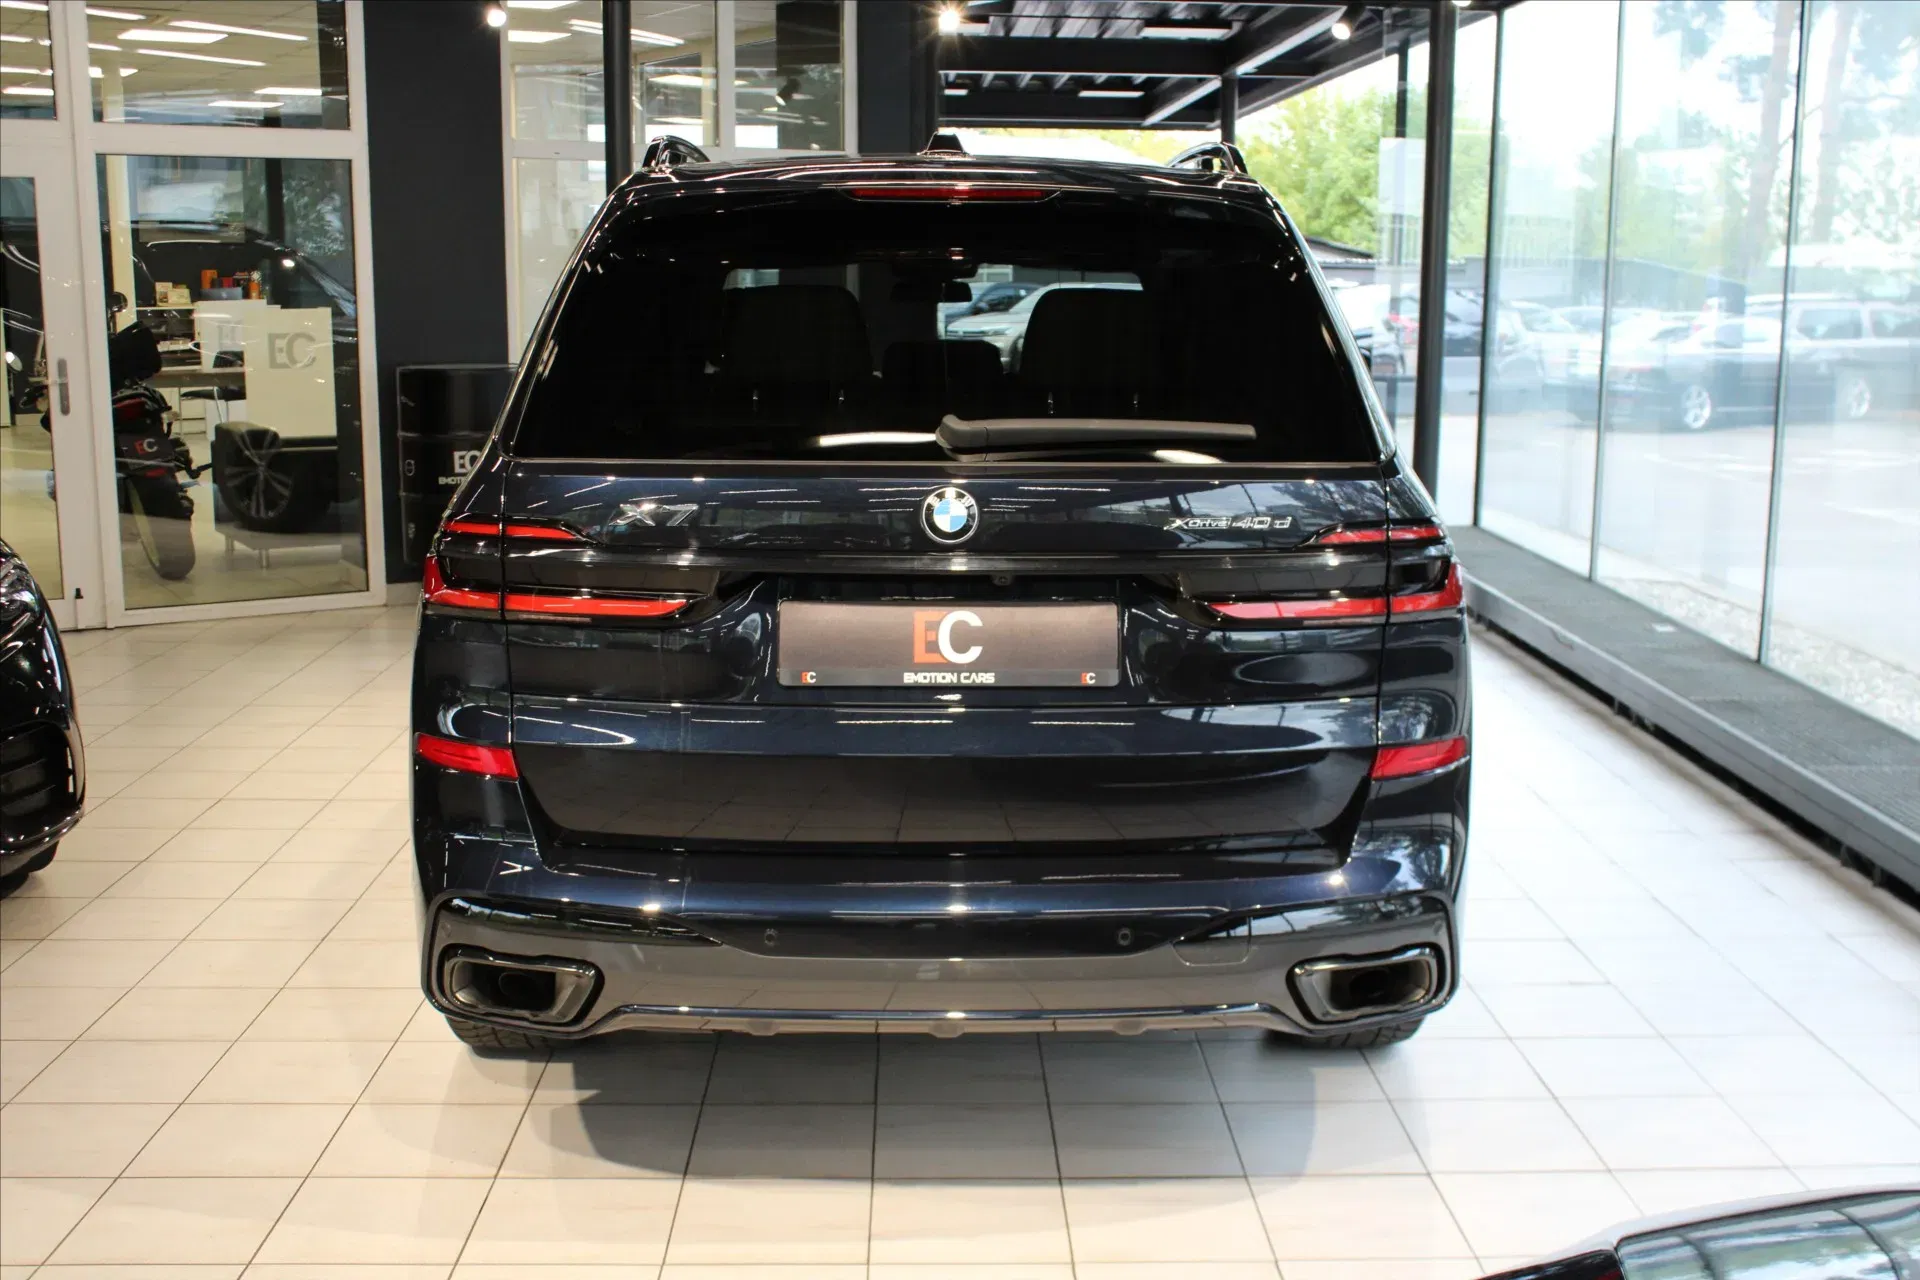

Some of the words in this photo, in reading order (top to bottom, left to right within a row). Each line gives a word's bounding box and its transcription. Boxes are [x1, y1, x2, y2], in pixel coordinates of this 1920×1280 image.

[268, 332, 317, 370] EC
[134, 438, 158, 455] EC
[608, 503, 699, 526] X7
[912, 610, 983, 664] EC
[801, 671, 816, 684] EC
[903, 672, 957, 684] EMOTION
[960, 672, 995, 684] CARS
[1081, 672, 1096, 684] EC
